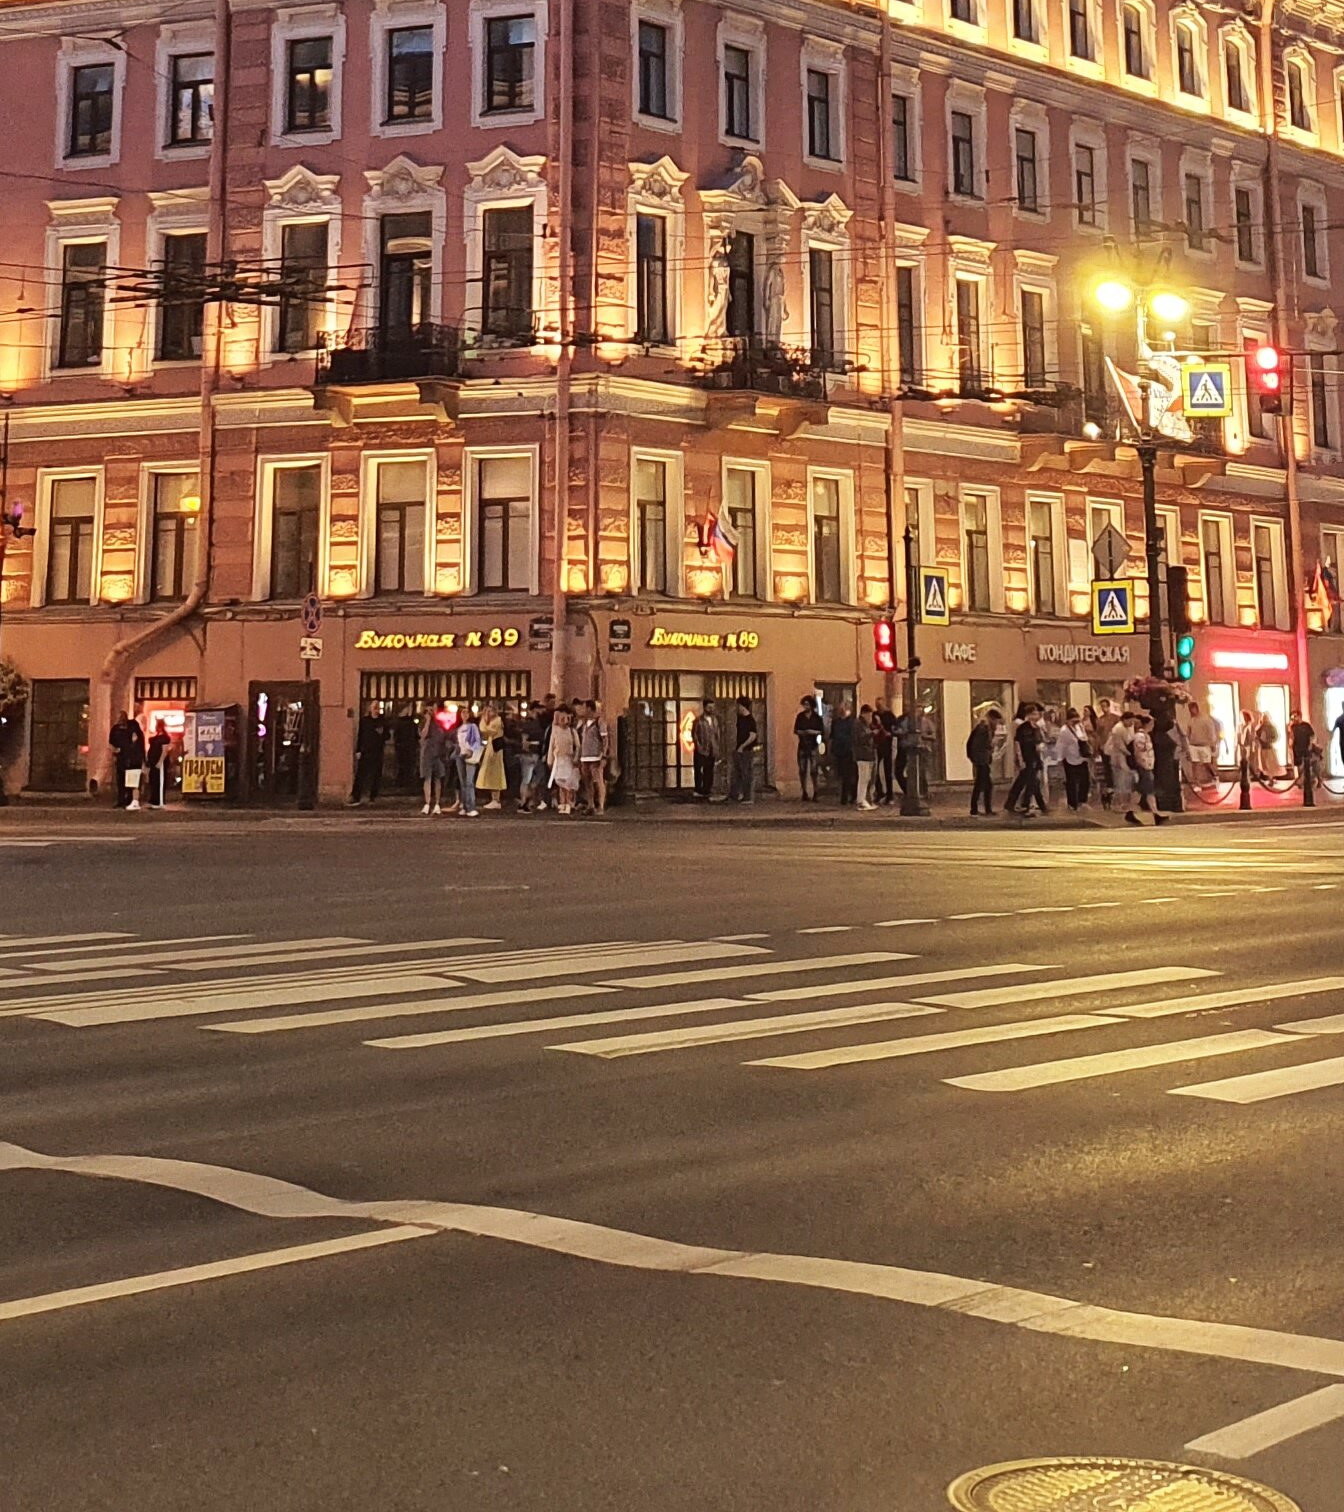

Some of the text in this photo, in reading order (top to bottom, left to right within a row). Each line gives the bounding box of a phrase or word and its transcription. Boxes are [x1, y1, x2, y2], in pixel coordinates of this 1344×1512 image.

[487, 627, 519, 648] 89
[738, 631, 759, 649] 89
[943, 642, 977, 662] КАФЕ
[1038, 643, 1130, 663] КОНДИТЕРСКАЯ
